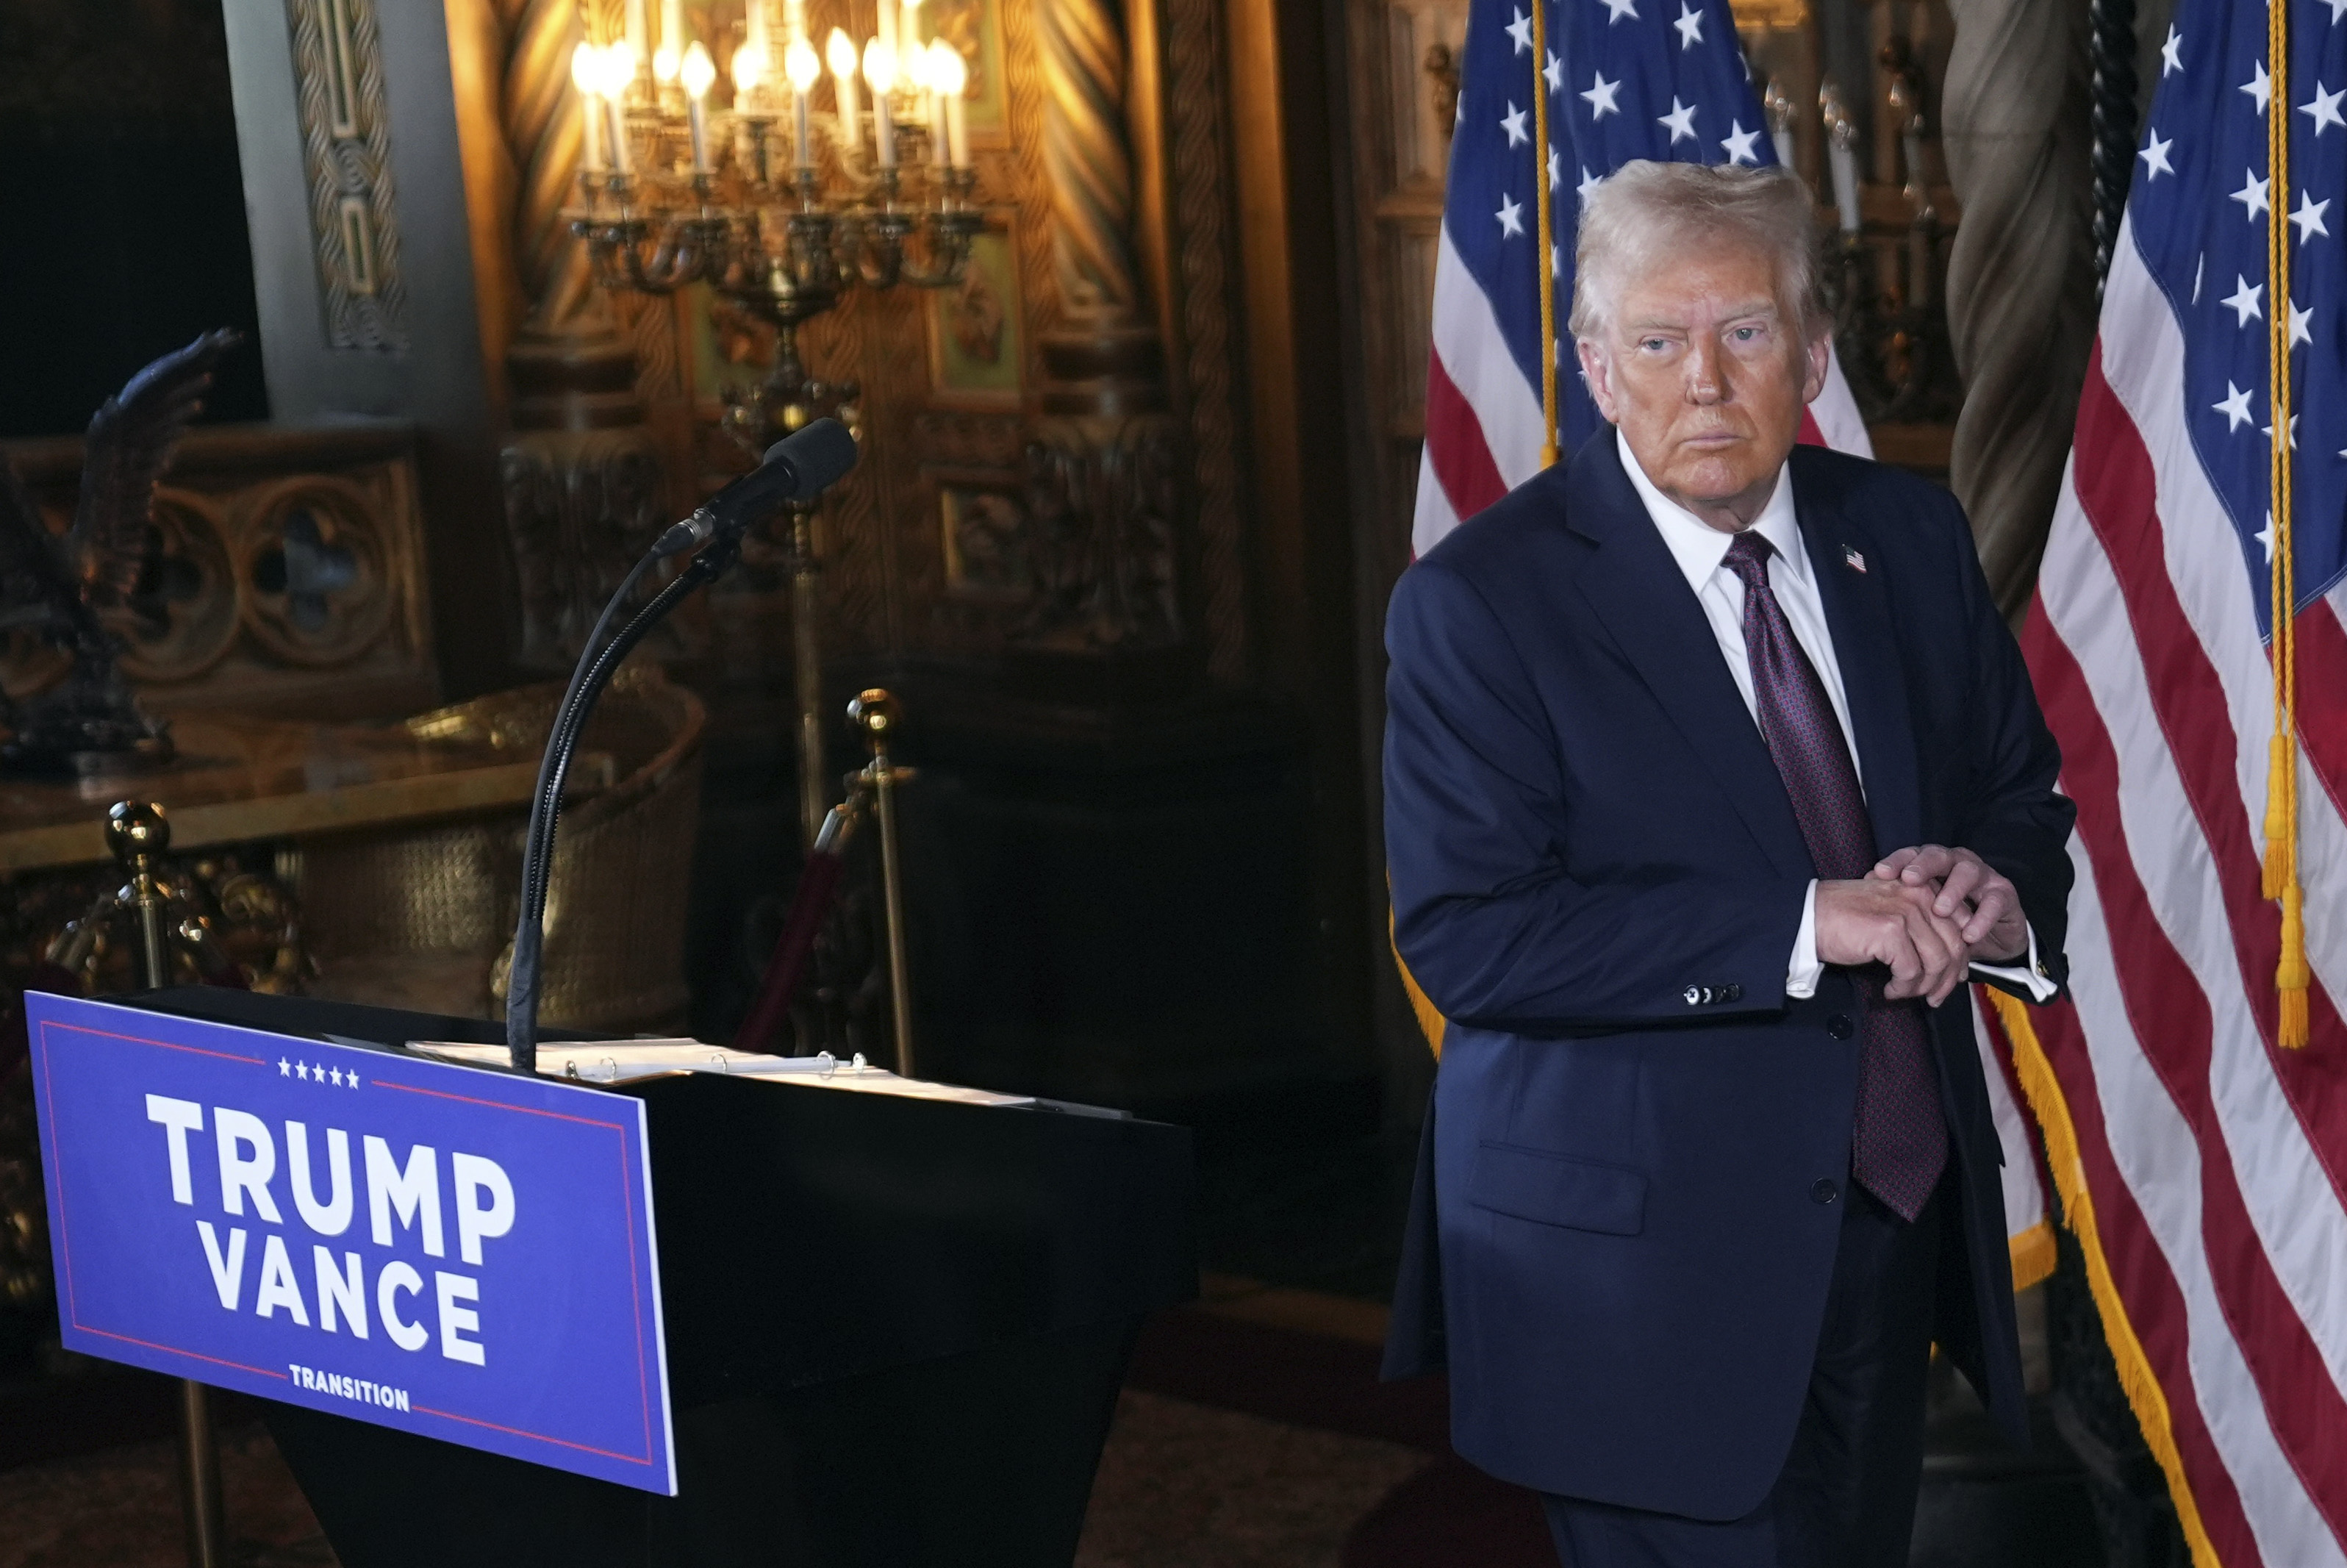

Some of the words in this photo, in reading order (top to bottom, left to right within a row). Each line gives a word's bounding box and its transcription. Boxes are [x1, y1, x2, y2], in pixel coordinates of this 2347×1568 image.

[145, 1093, 515, 1266] TRUMP
[196, 1220, 485, 1366] VANCE
[289, 1364, 409, 1412] TRANSITION
